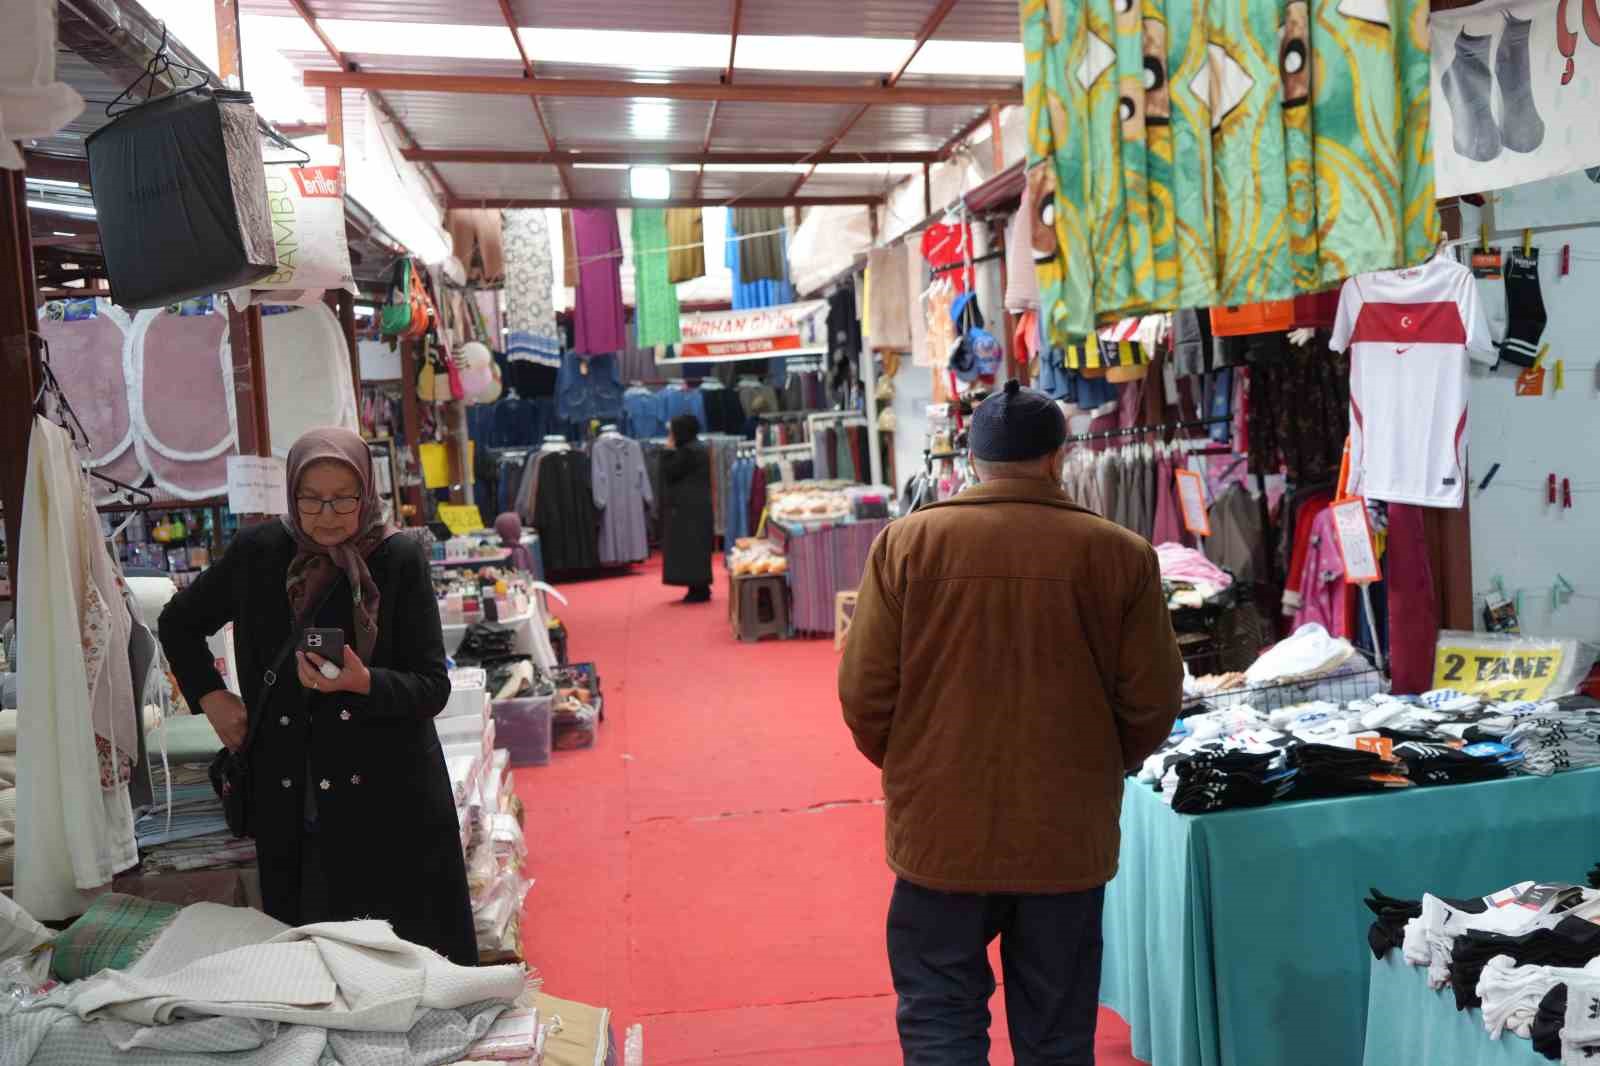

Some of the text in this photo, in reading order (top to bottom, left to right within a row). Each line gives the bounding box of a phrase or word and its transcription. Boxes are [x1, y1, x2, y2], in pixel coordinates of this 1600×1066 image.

[264, 176, 299, 283] BAMBU
[1443, 654, 1553, 681] 2 TANE
